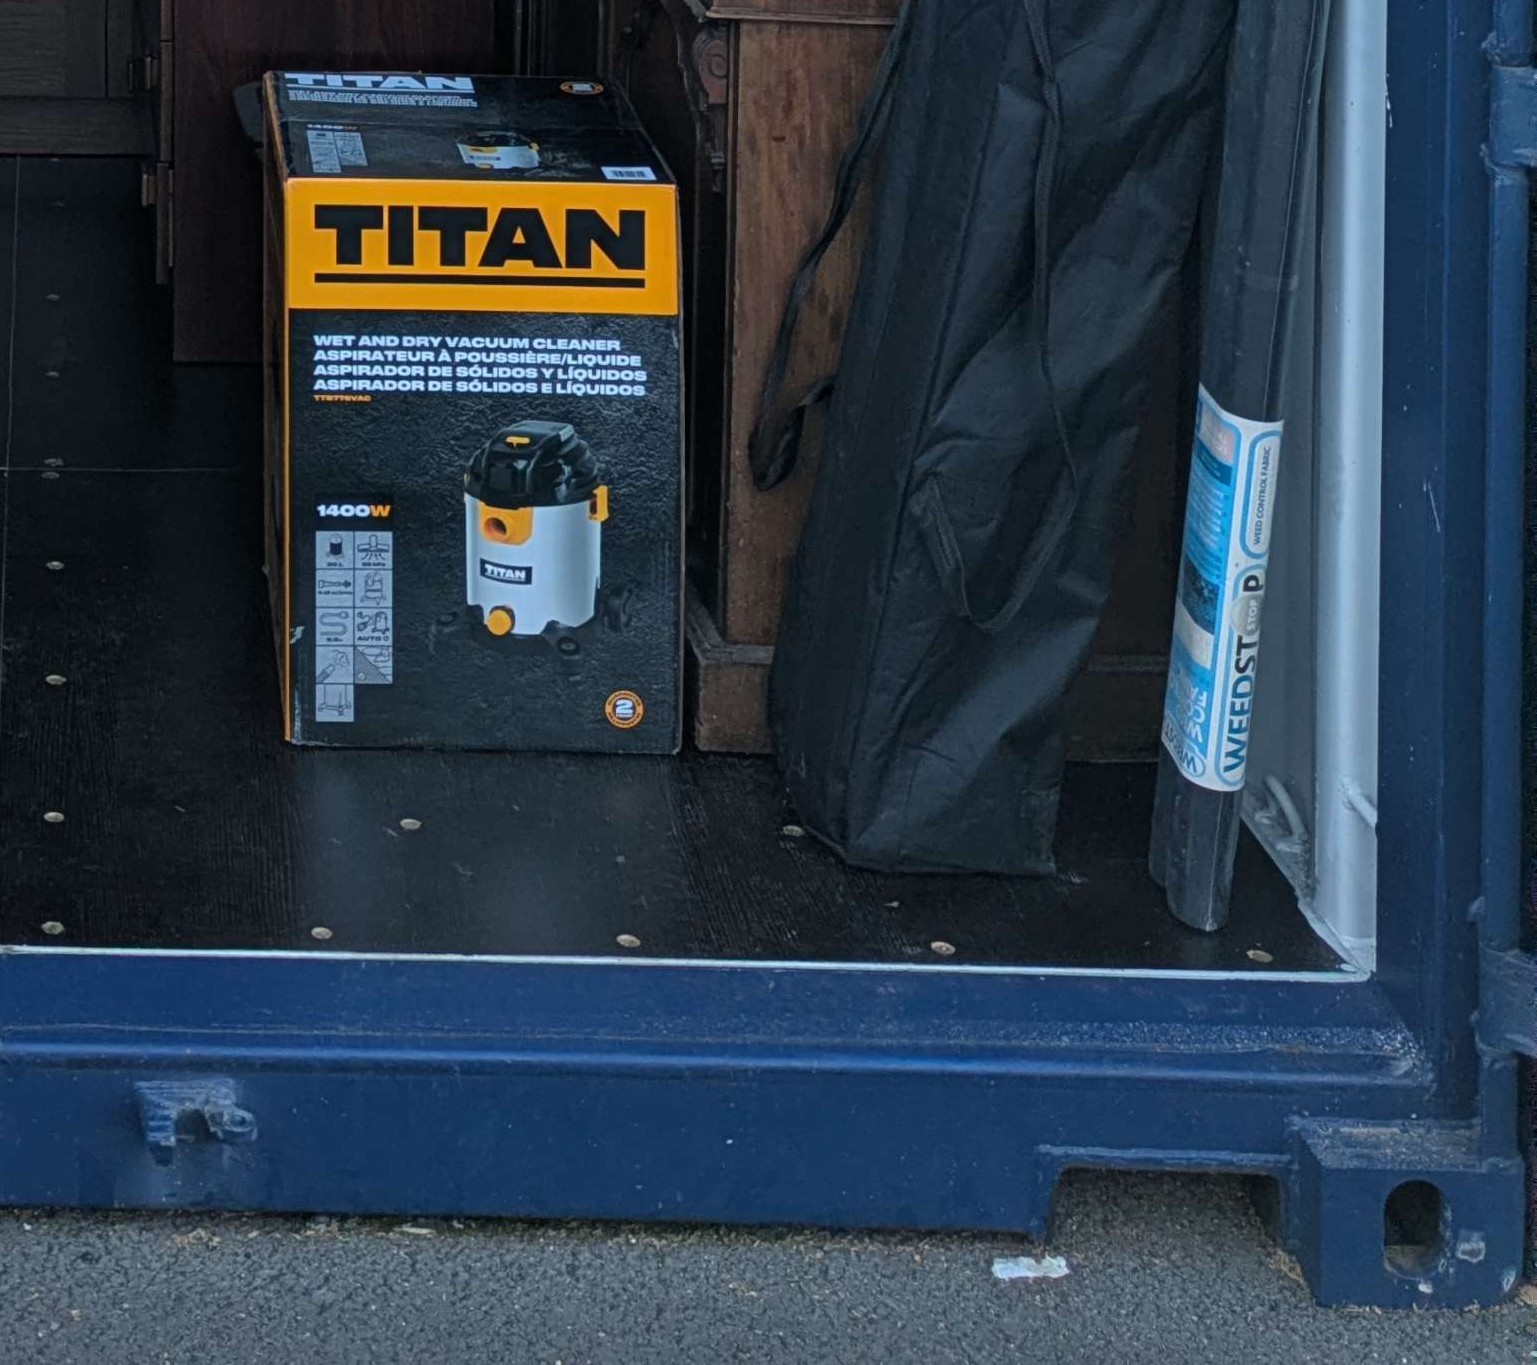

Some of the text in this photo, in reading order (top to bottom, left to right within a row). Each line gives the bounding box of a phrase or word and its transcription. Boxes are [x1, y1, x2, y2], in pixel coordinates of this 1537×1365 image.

[284, 73, 475, 90] TITAN
[314, 204, 646, 271] TITAN
[313, 335, 621, 351] WET AND DRY VACUUM CLEANER
[313, 349, 642, 367] ASPIRATEUR À POUSSIÈRE/LIQUIDE
[313, 364, 647, 382] ASPIRADOR DE SÓLIDOS Y LÍQUIDOS
[313, 379, 646, 397] ASPIRADOR DE SÓLIDOS E LÍQUIDOS
[1256, 480, 1268, 519] CONTROL
[317, 504, 391, 517] 1400W
[1253, 520, 1263, 546] WEED
[484, 563, 527, 580] TITAN
[1247, 599, 1258, 630] STOP
